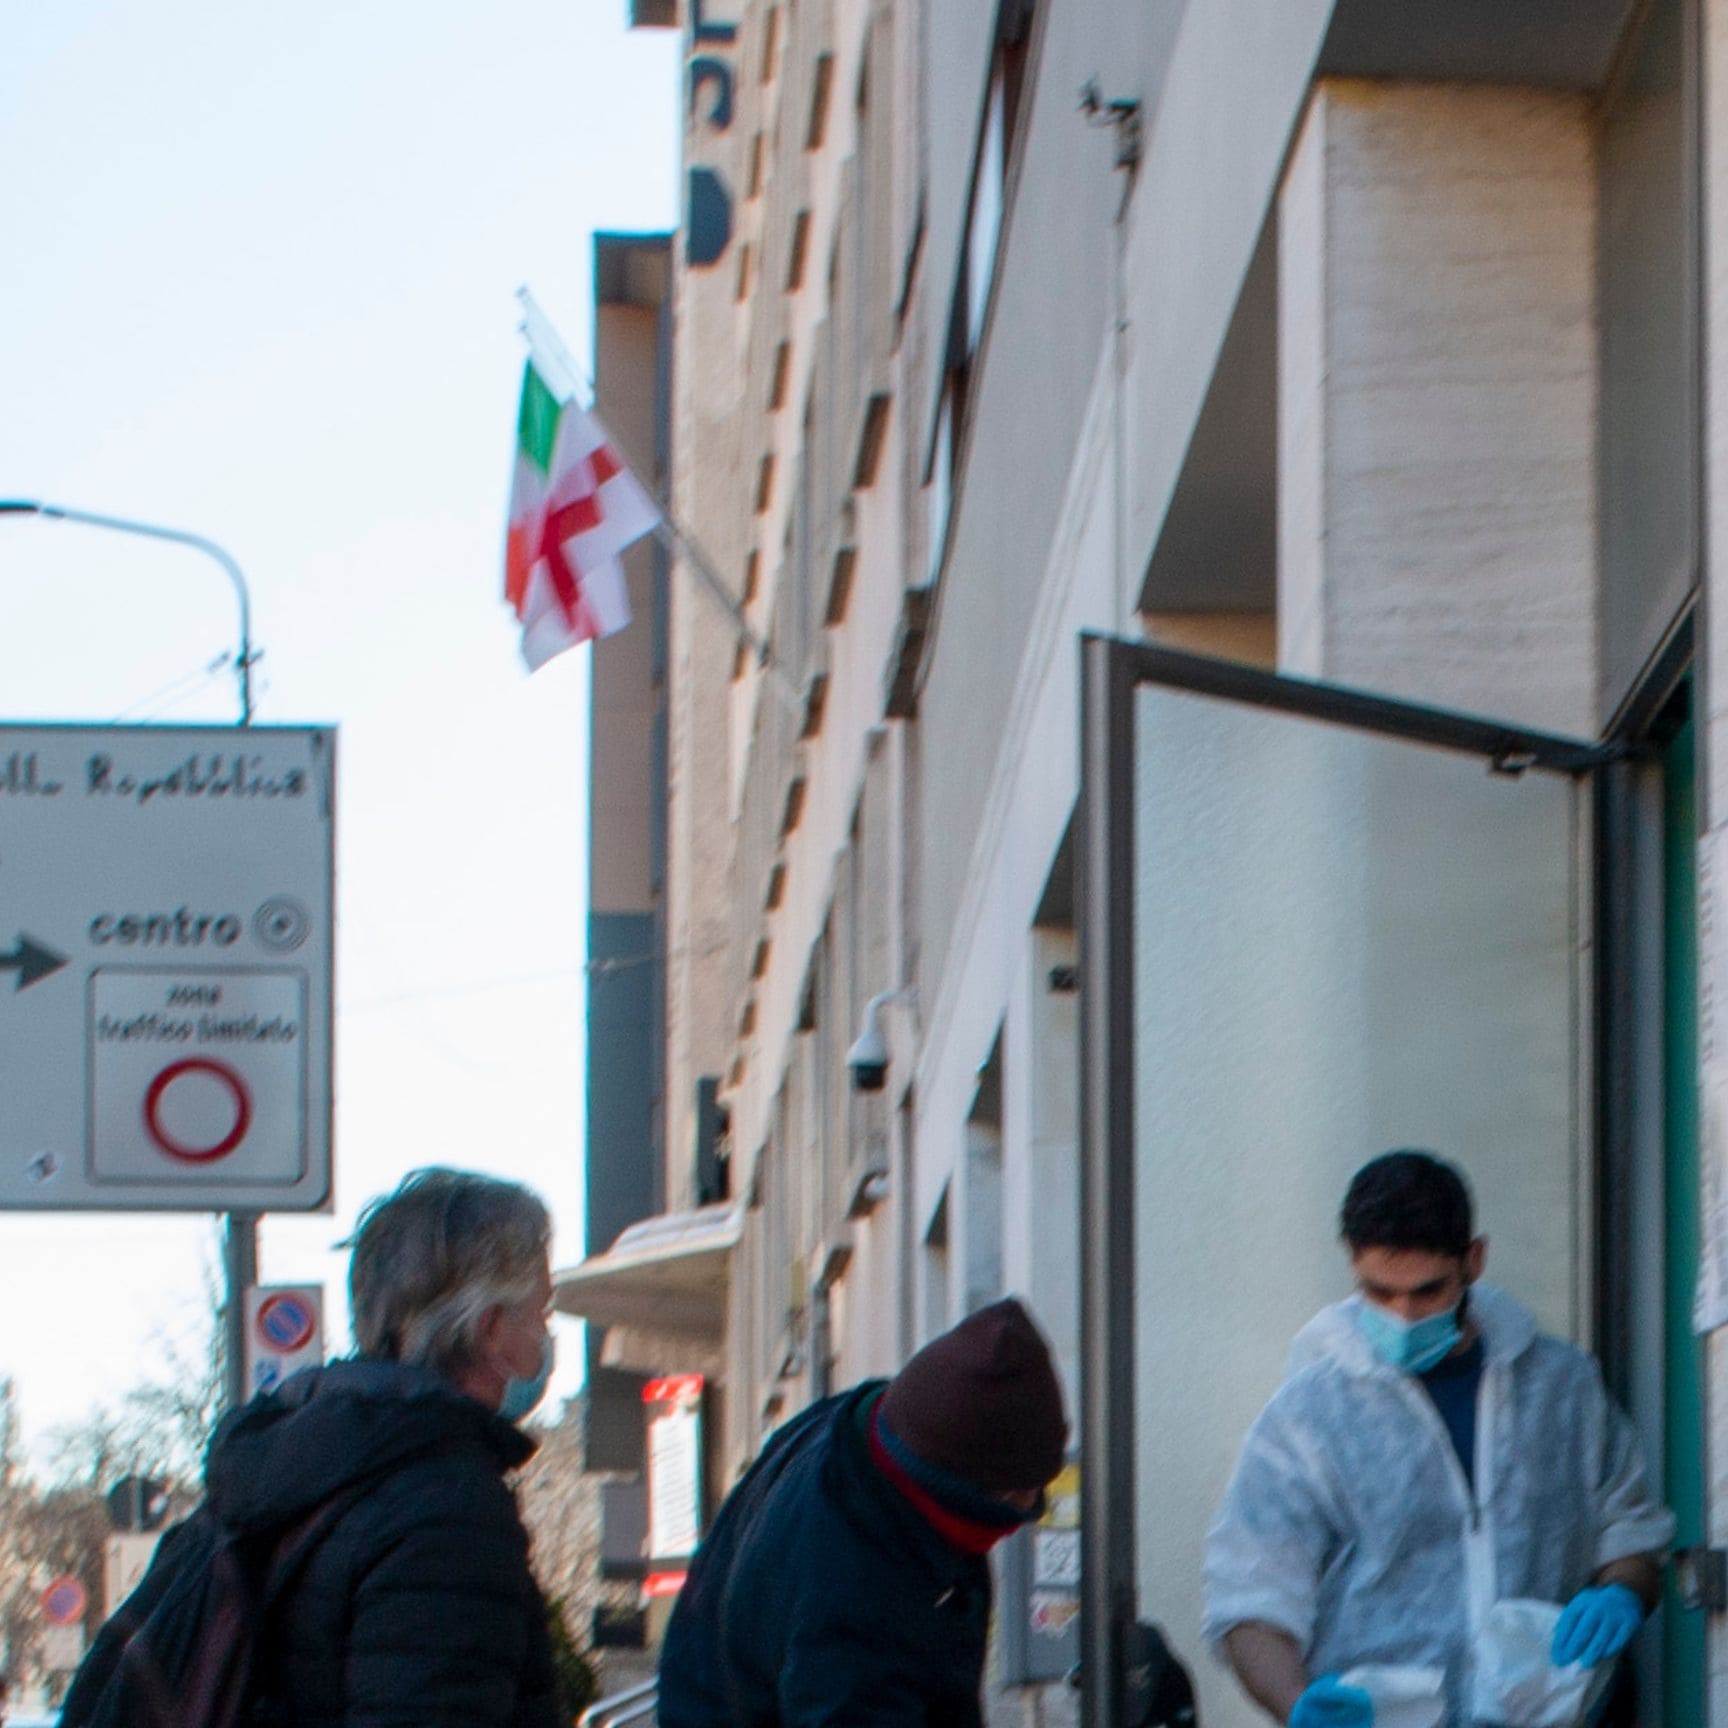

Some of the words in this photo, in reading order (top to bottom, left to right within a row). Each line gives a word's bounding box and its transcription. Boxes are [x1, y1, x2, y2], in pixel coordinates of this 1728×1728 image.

[87, 753, 306, 804] Repubblica
[88, 905, 243, 947] centro
[99, 1014, 194, 1043] traffico
